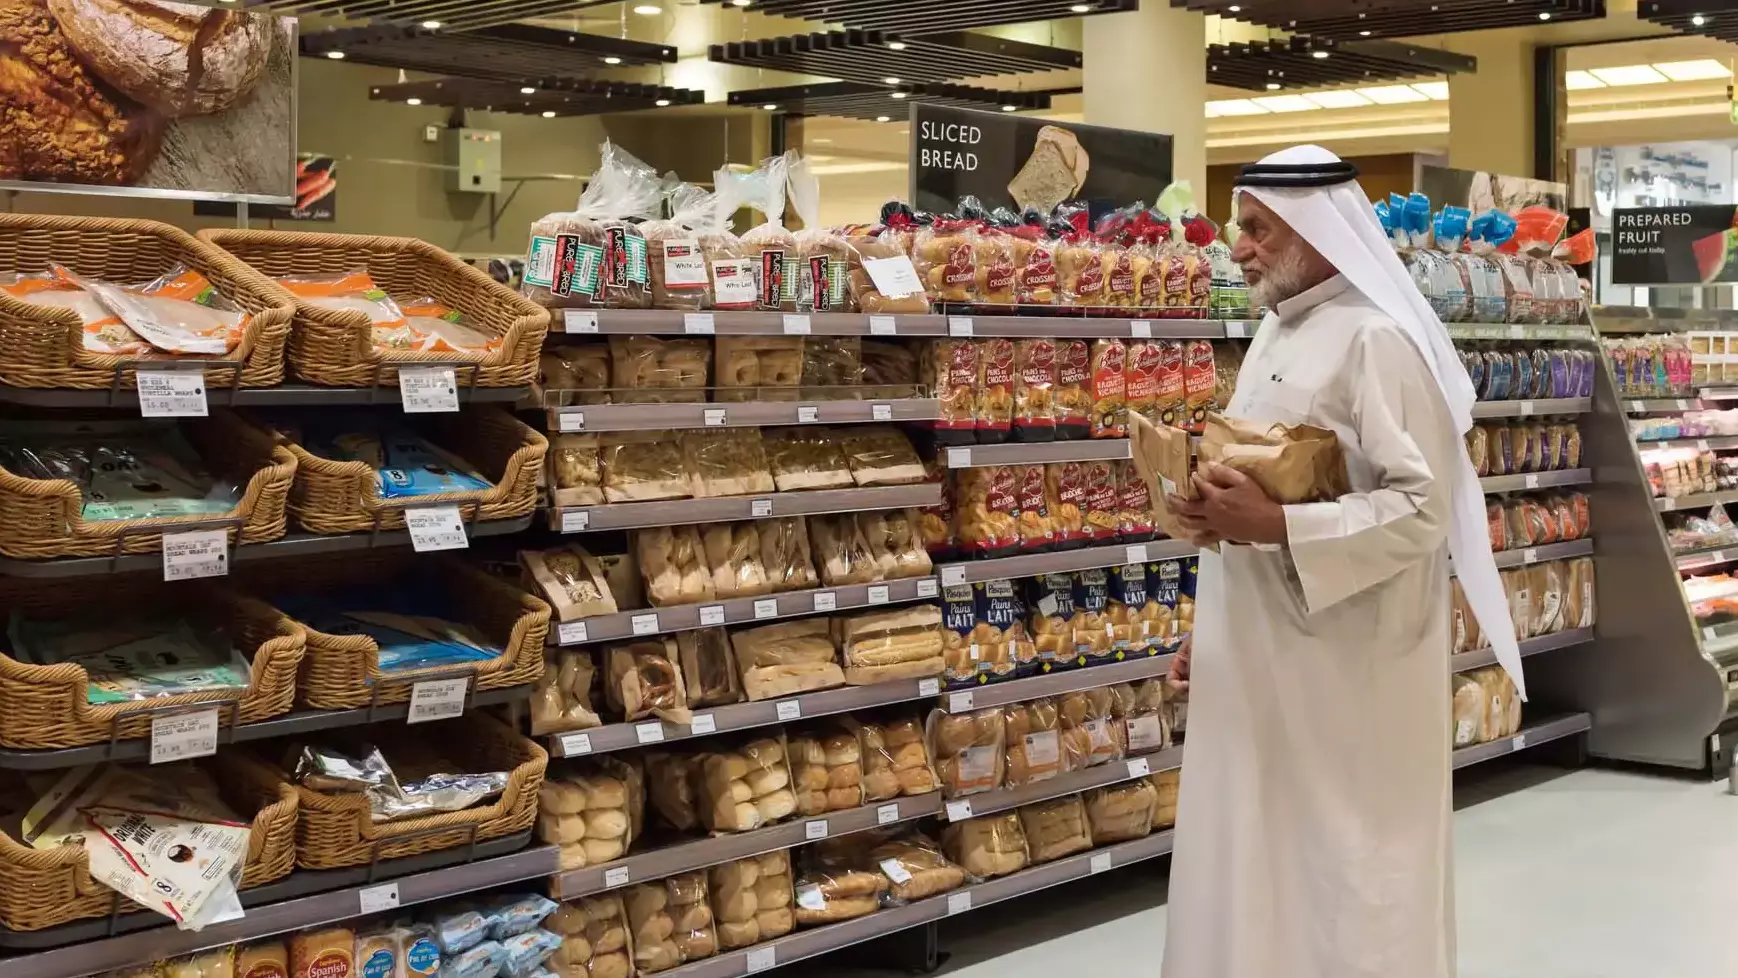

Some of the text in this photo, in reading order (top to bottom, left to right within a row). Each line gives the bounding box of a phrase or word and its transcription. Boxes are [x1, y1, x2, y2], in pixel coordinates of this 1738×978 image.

[921, 121, 981, 144] SLICED
[921, 149, 978, 171] BREAD
[1619, 213, 1692, 227] PREPARED
[1619, 230, 1661, 244] FRUIT
[391, 470, 403, 480] 8
[990, 598, 1011, 609] Pains
[1124, 591, 1147, 604] LAIT
[950, 602, 971, 614] Pains
[1059, 600, 1075, 613] AIT
[947, 613, 975, 628] LAIT
[987, 609, 1013, 623] LAIT
[113, 813, 147, 842] ORIGINAL
[132, 823, 157, 846] WHITE
[156, 881, 172, 893] 8
[311, 962, 347, 978] Spanish
